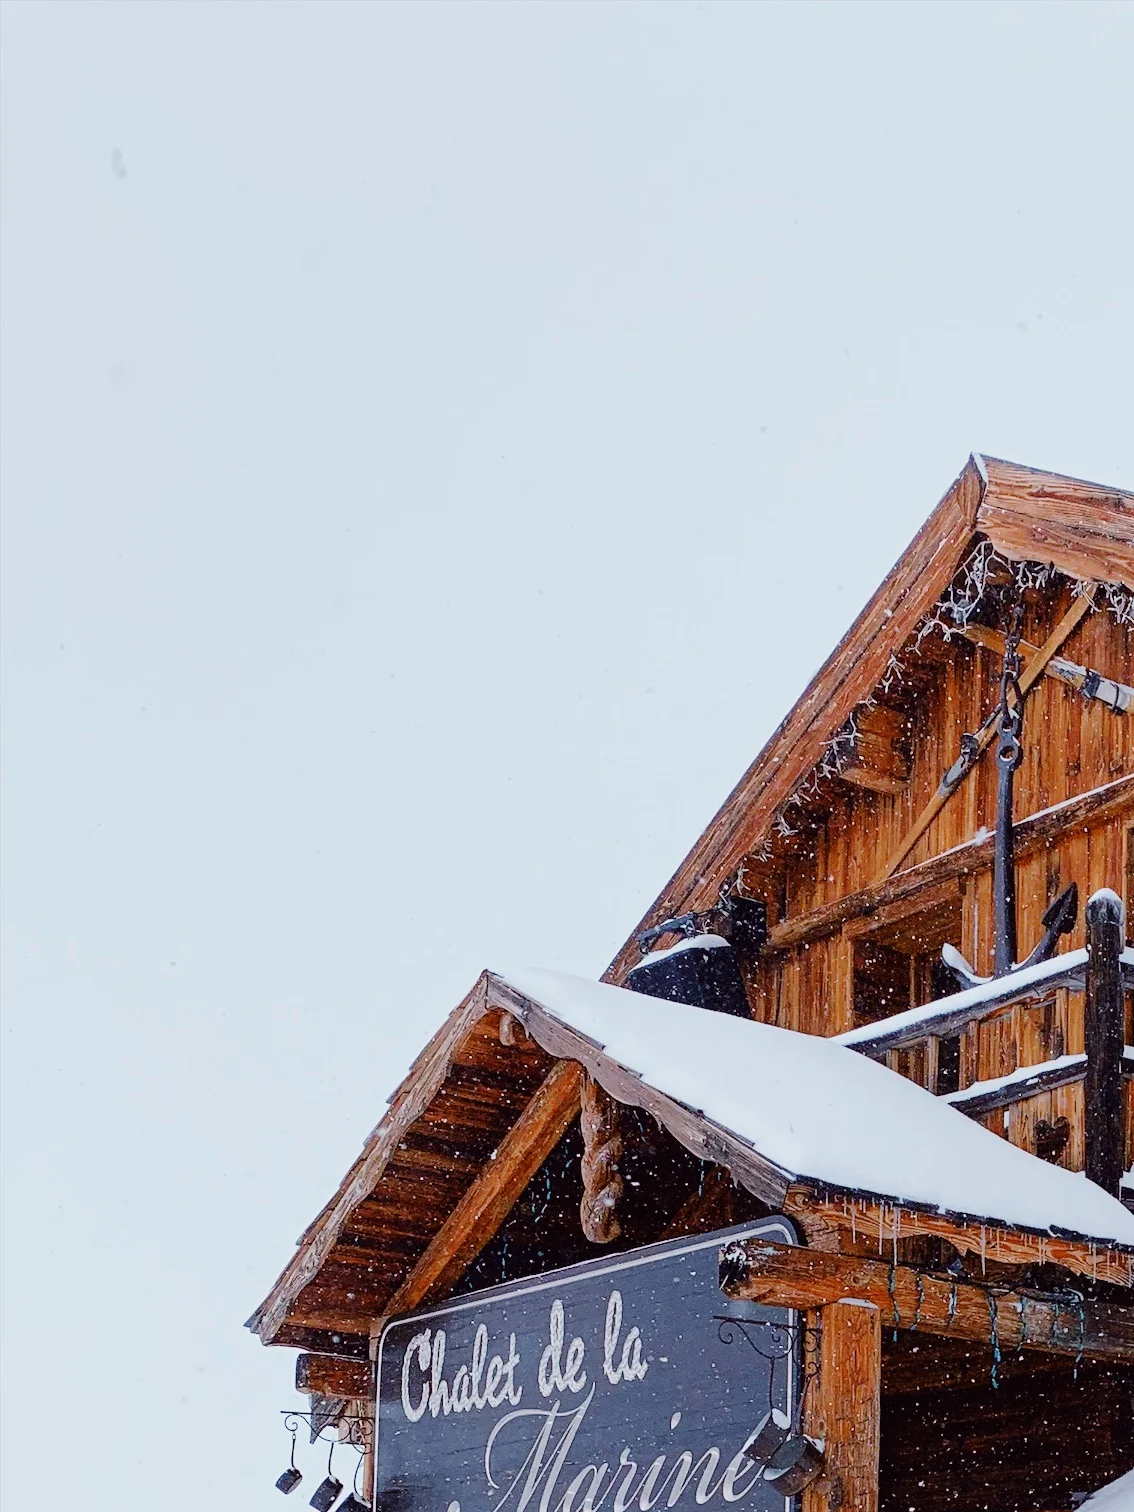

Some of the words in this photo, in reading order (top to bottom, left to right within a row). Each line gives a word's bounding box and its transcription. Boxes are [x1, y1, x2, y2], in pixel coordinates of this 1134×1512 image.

[401, 1322, 523, 1423] Chalet
[537, 1298, 588, 1398] de
[602, 1289, 649, 1385] la
